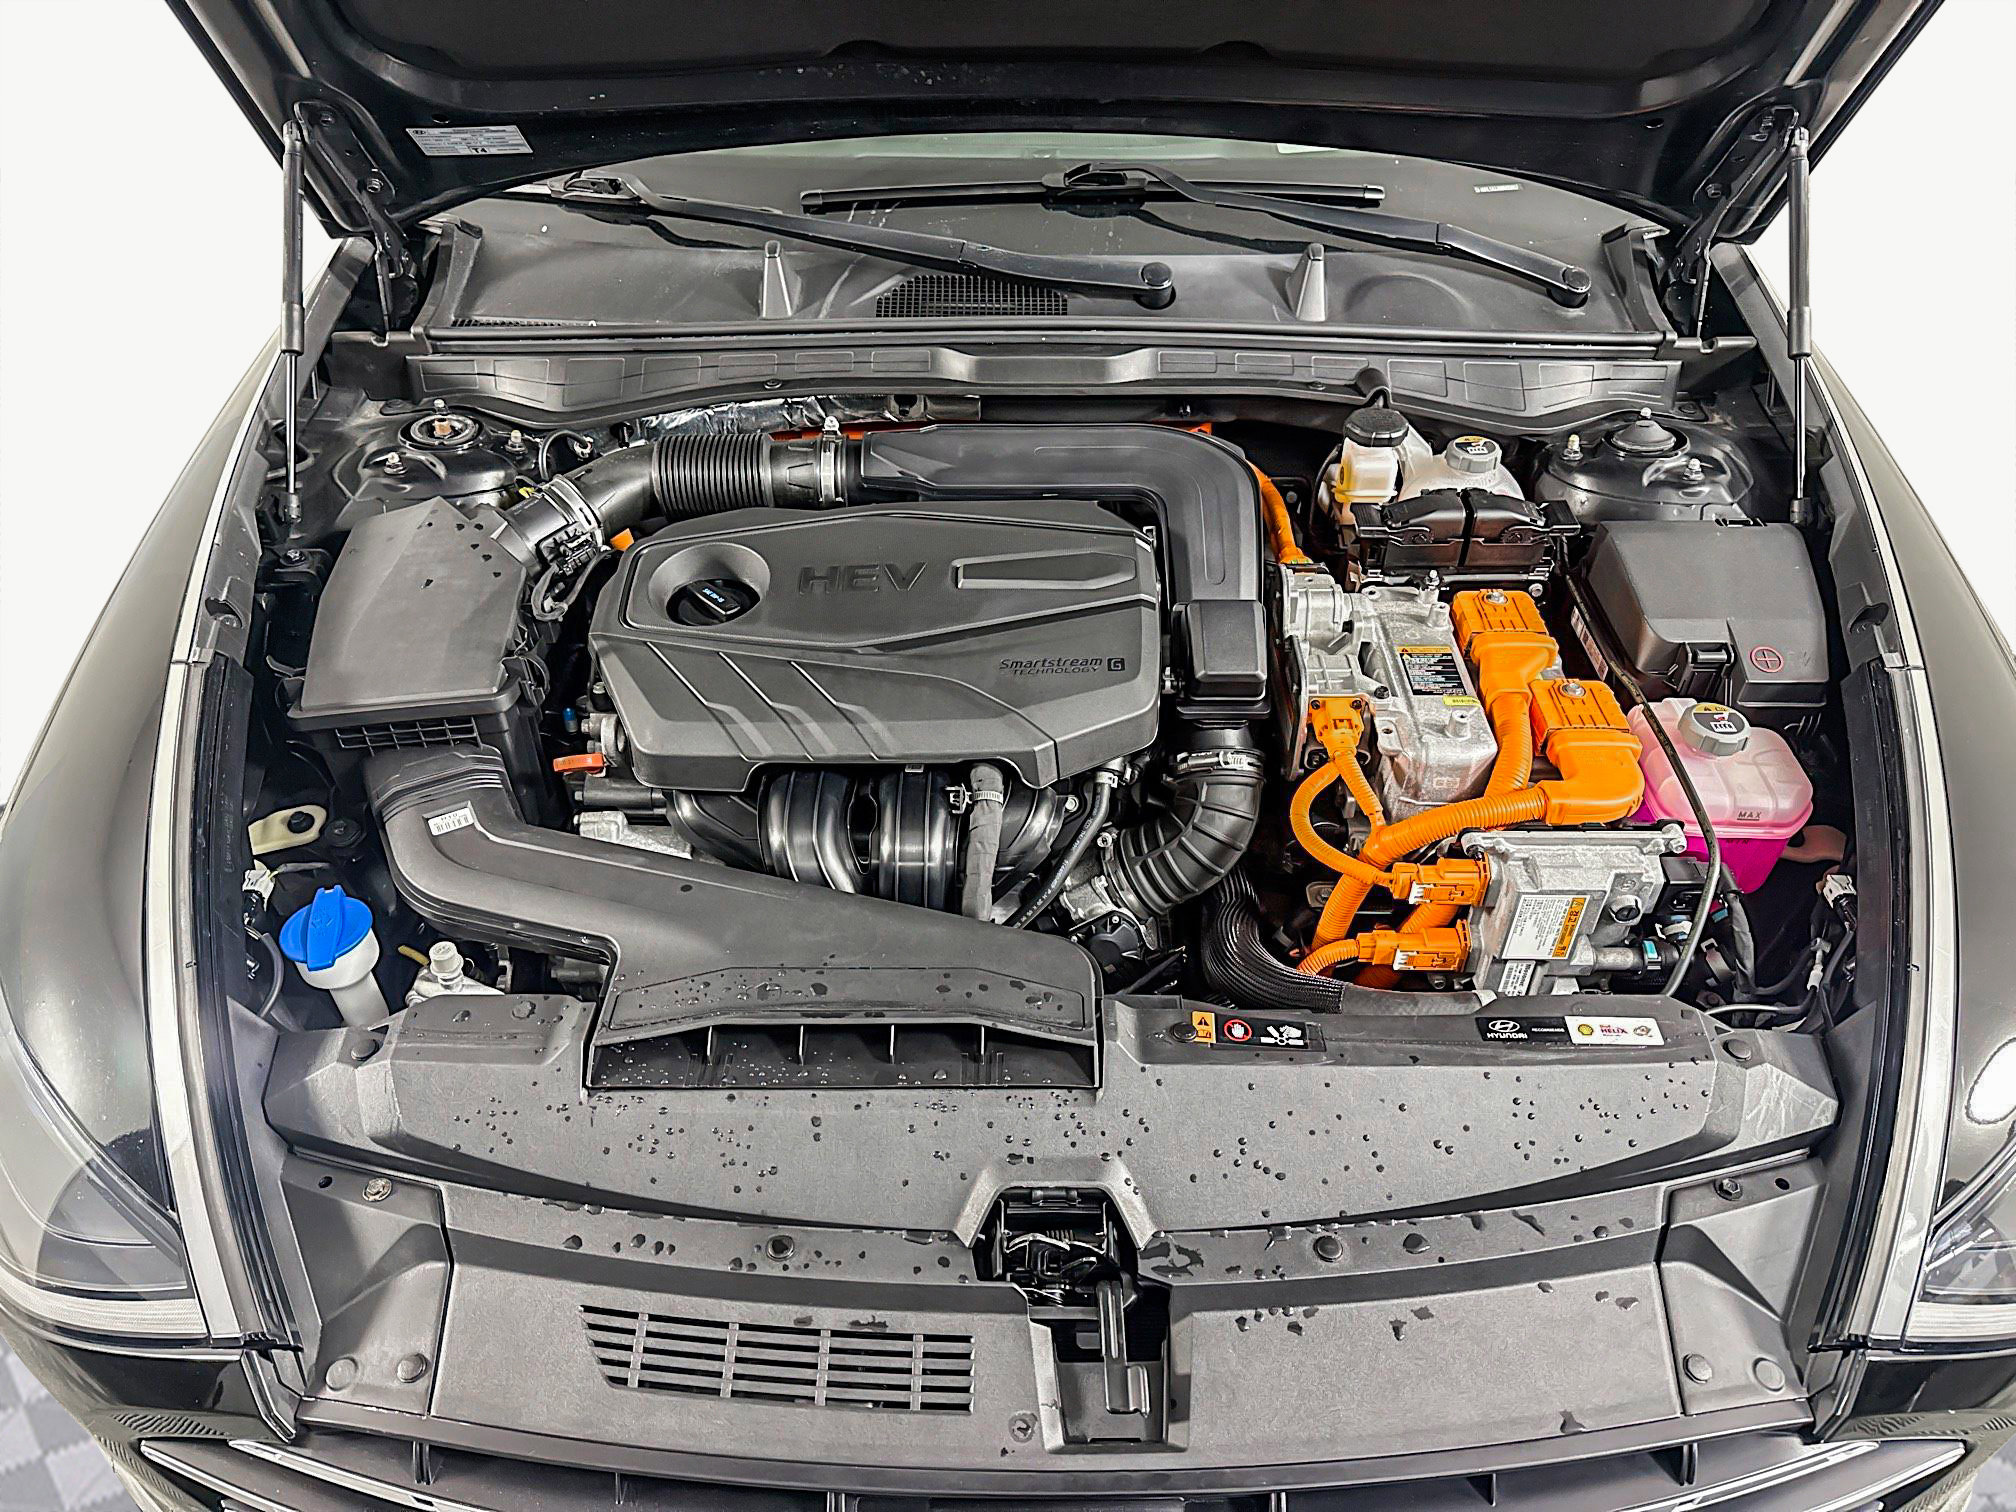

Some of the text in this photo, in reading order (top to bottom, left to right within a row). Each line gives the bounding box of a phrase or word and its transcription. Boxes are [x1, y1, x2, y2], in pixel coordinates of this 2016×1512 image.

[799, 561, 928, 595] HEV
[999, 657, 1124, 671] Smartstream G
[1013, 666, 1099, 675] TECHNOLOGY
